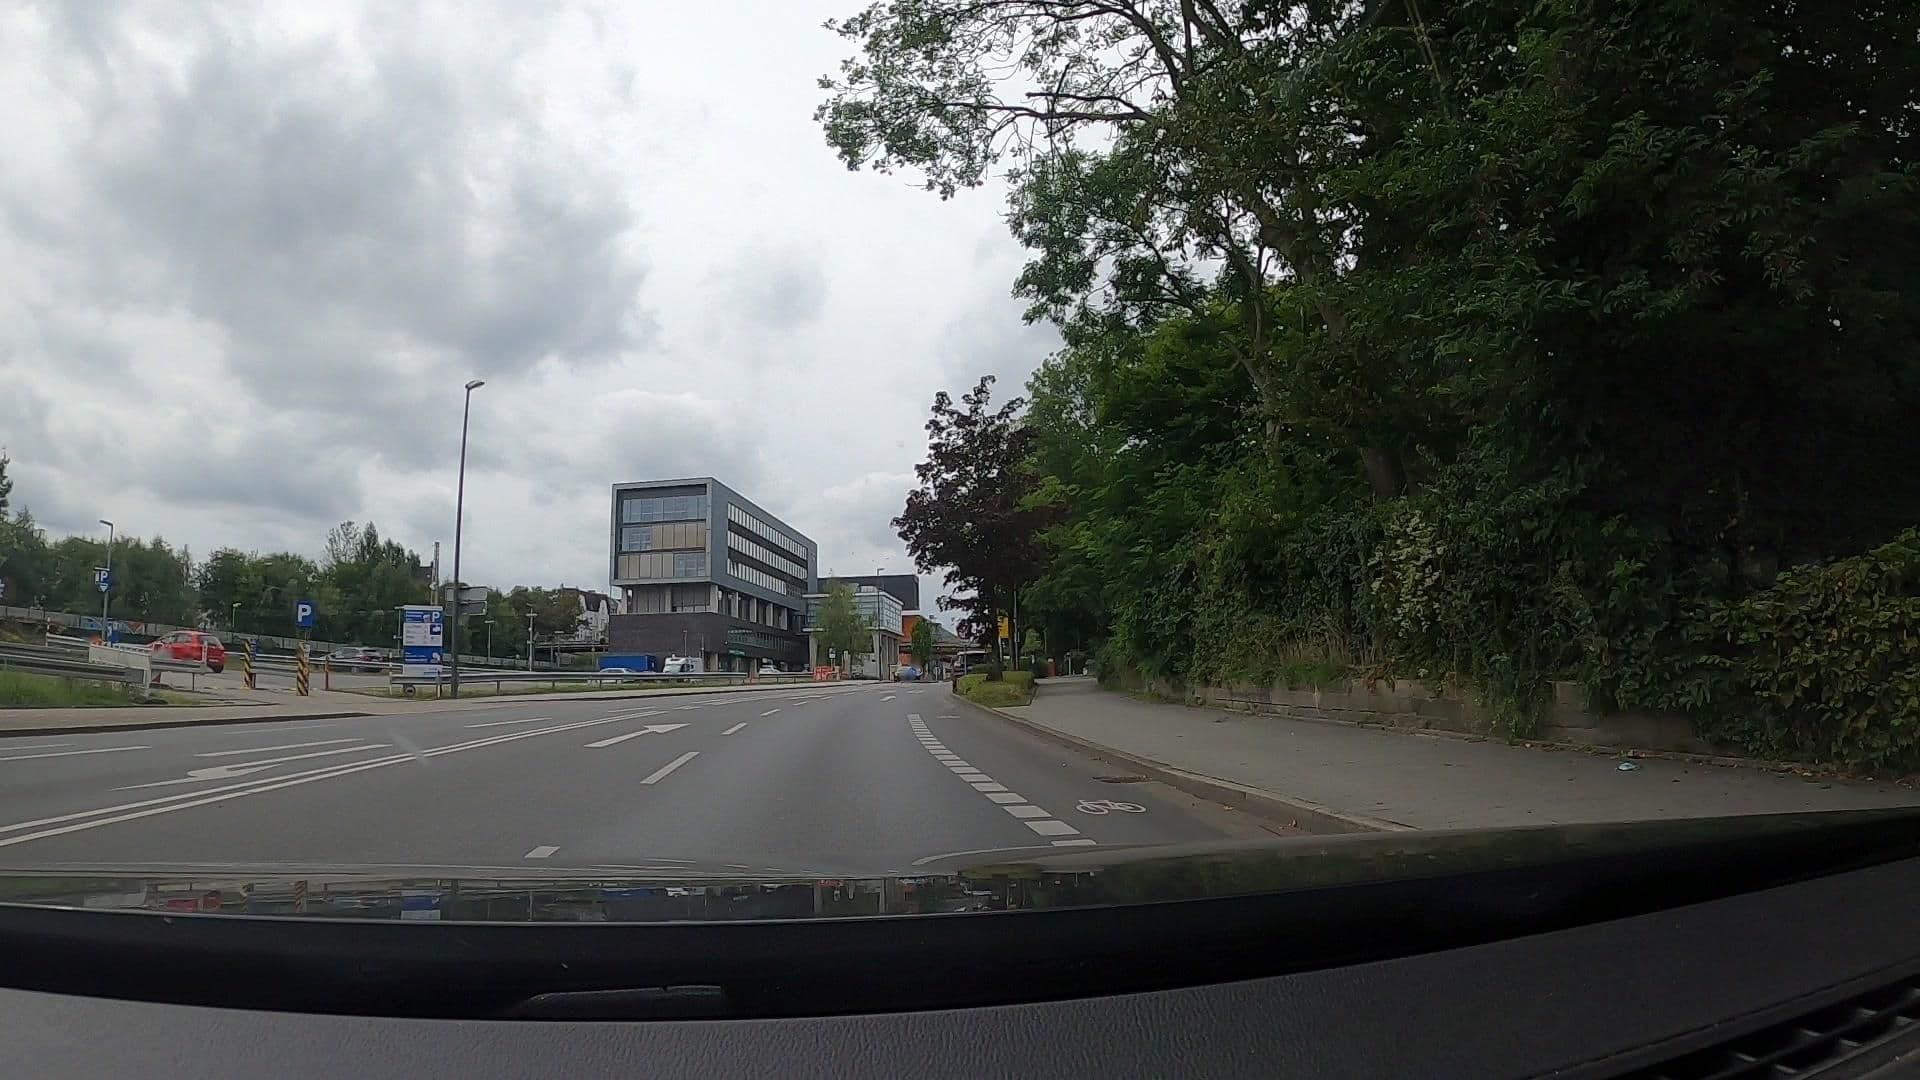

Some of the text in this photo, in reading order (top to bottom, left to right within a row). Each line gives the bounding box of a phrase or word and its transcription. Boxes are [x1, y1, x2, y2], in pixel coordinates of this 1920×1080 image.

[100, 570, 108, 582] P
[297, 603, 312, 622] P
[432, 611, 440, 622] P
